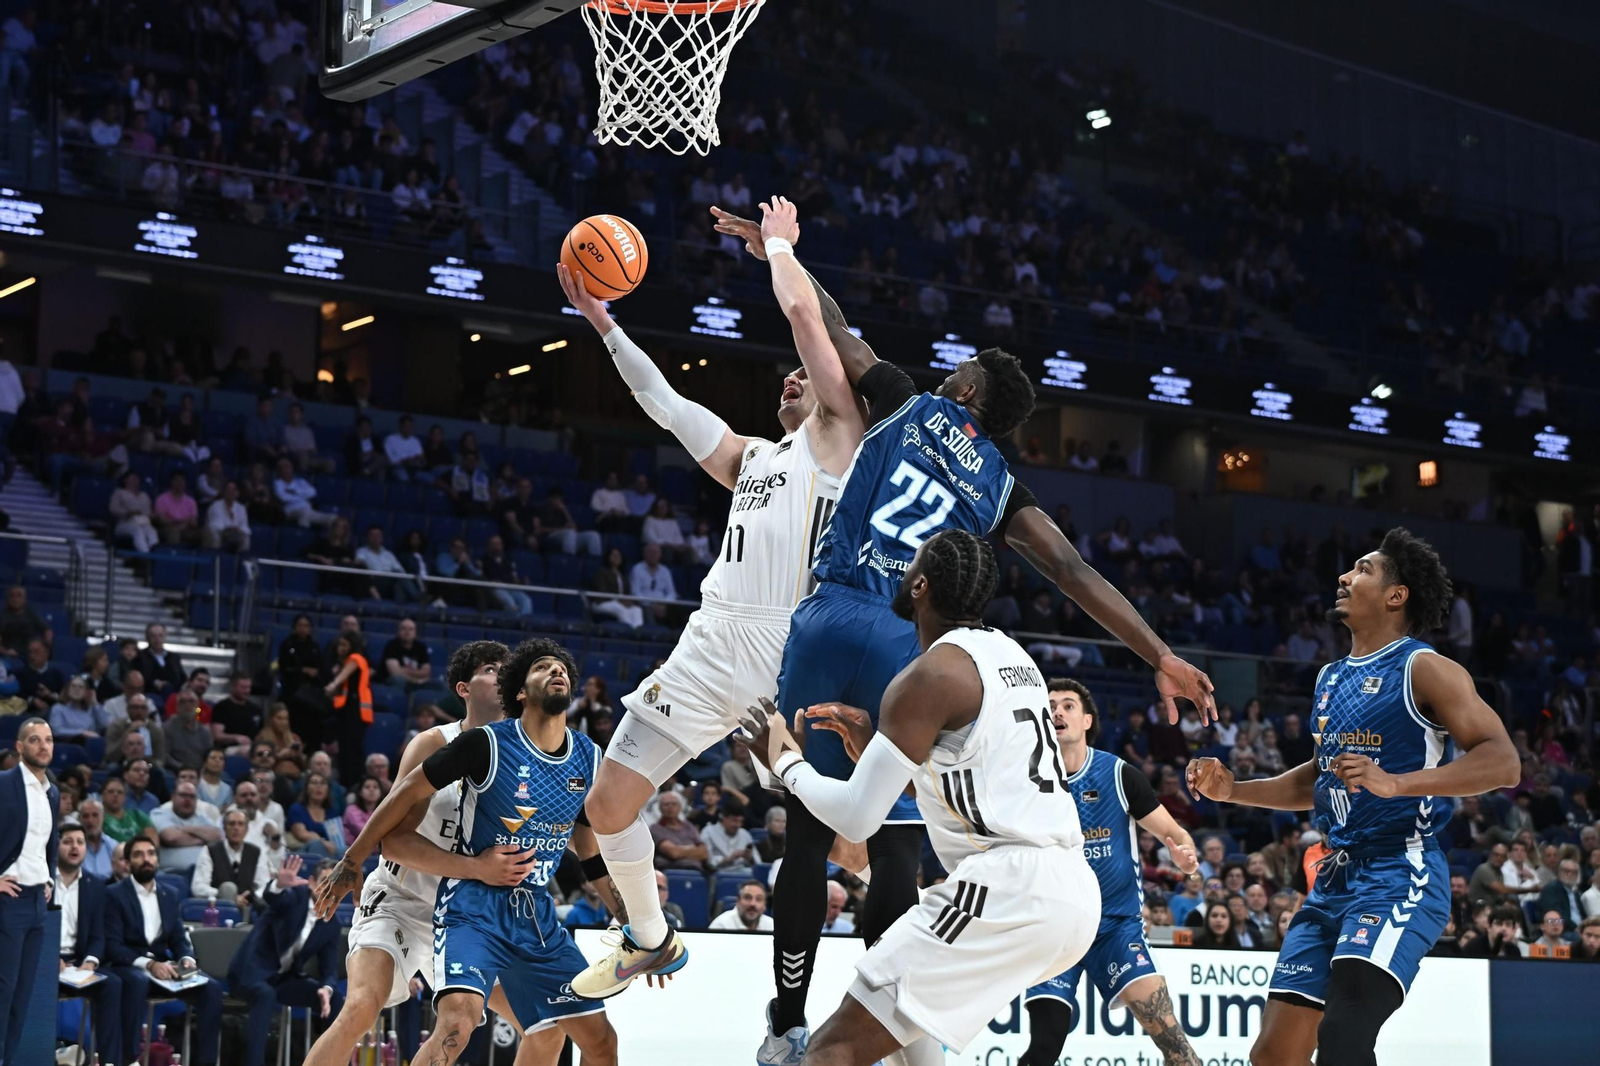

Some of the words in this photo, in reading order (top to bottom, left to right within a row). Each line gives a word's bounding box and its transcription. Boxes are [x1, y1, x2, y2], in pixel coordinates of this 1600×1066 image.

[586, 242, 605, 263] acb
[601, 216, 637, 264] Wilson
[924, 411, 950, 436] DE
[941, 425, 984, 475] SOUSA
[736, 493, 772, 513] BETTER
[958, 480, 983, 501] salud
[869, 459, 957, 551] 22
[725, 523, 745, 563] 11
[1108, 962, 1132, 989] LEXUS
[1190, 963, 1269, 987] BANCO
[1136, 1051, 1166, 1066] tu
